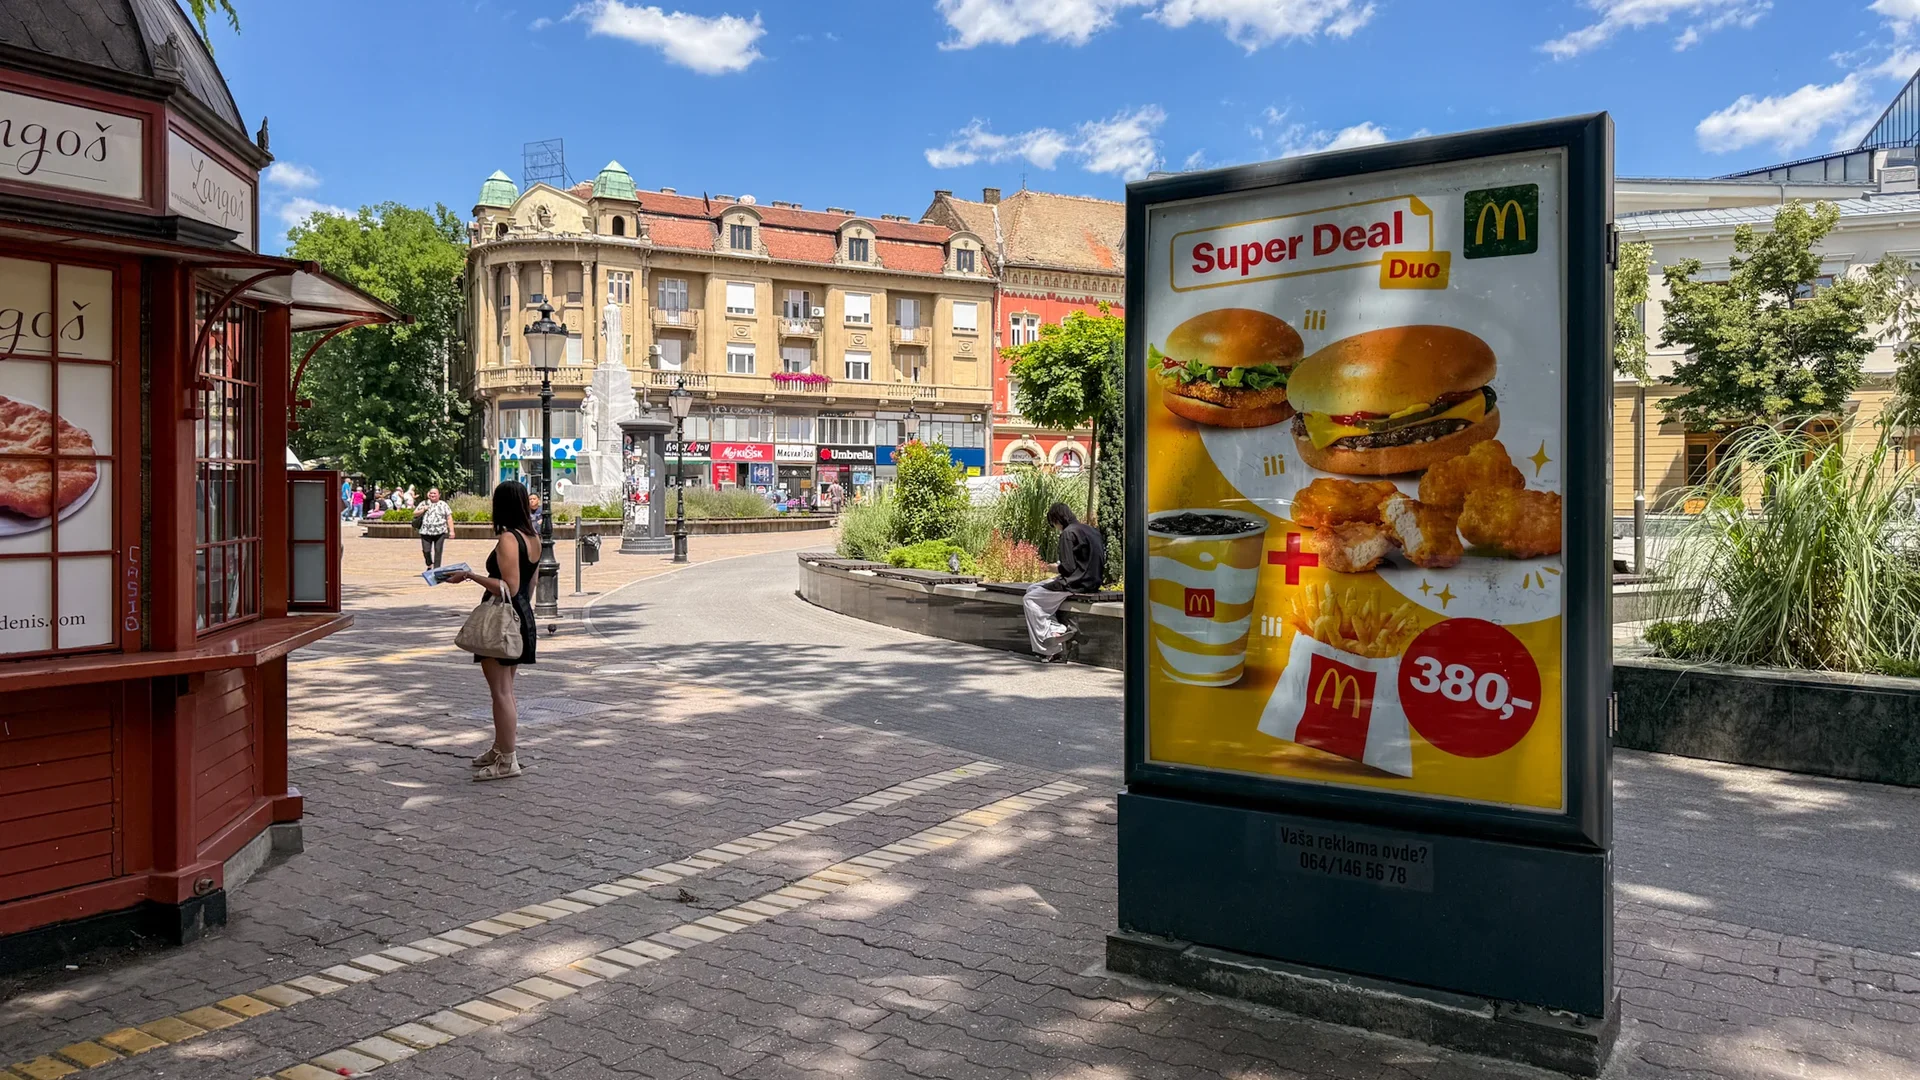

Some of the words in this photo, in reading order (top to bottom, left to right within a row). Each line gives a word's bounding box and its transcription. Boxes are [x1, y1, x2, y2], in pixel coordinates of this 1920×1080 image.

[190, 151, 246, 228] Langoš
[1191, 234, 1303, 277] Super
[1312, 210, 1404, 257] Deal
[1388, 258, 1441, 280] Duo
[1303, 309, 1327, 331] ili
[830, 448, 874, 460] Umbrella
[1262, 453, 1286, 478] ili
[0, 613, 86, 631] denis.om
[1260, 615, 1283, 638] ili
[1280, 826, 1314, 848] Vaša
[1318, 833, 1378, 857] reklama
[1382, 844, 1428, 864] ovde?
[1300, 851, 1362, 877] 064/146
[1365, 861, 1385, 882] 56
[1389, 864, 1407, 884] 78
